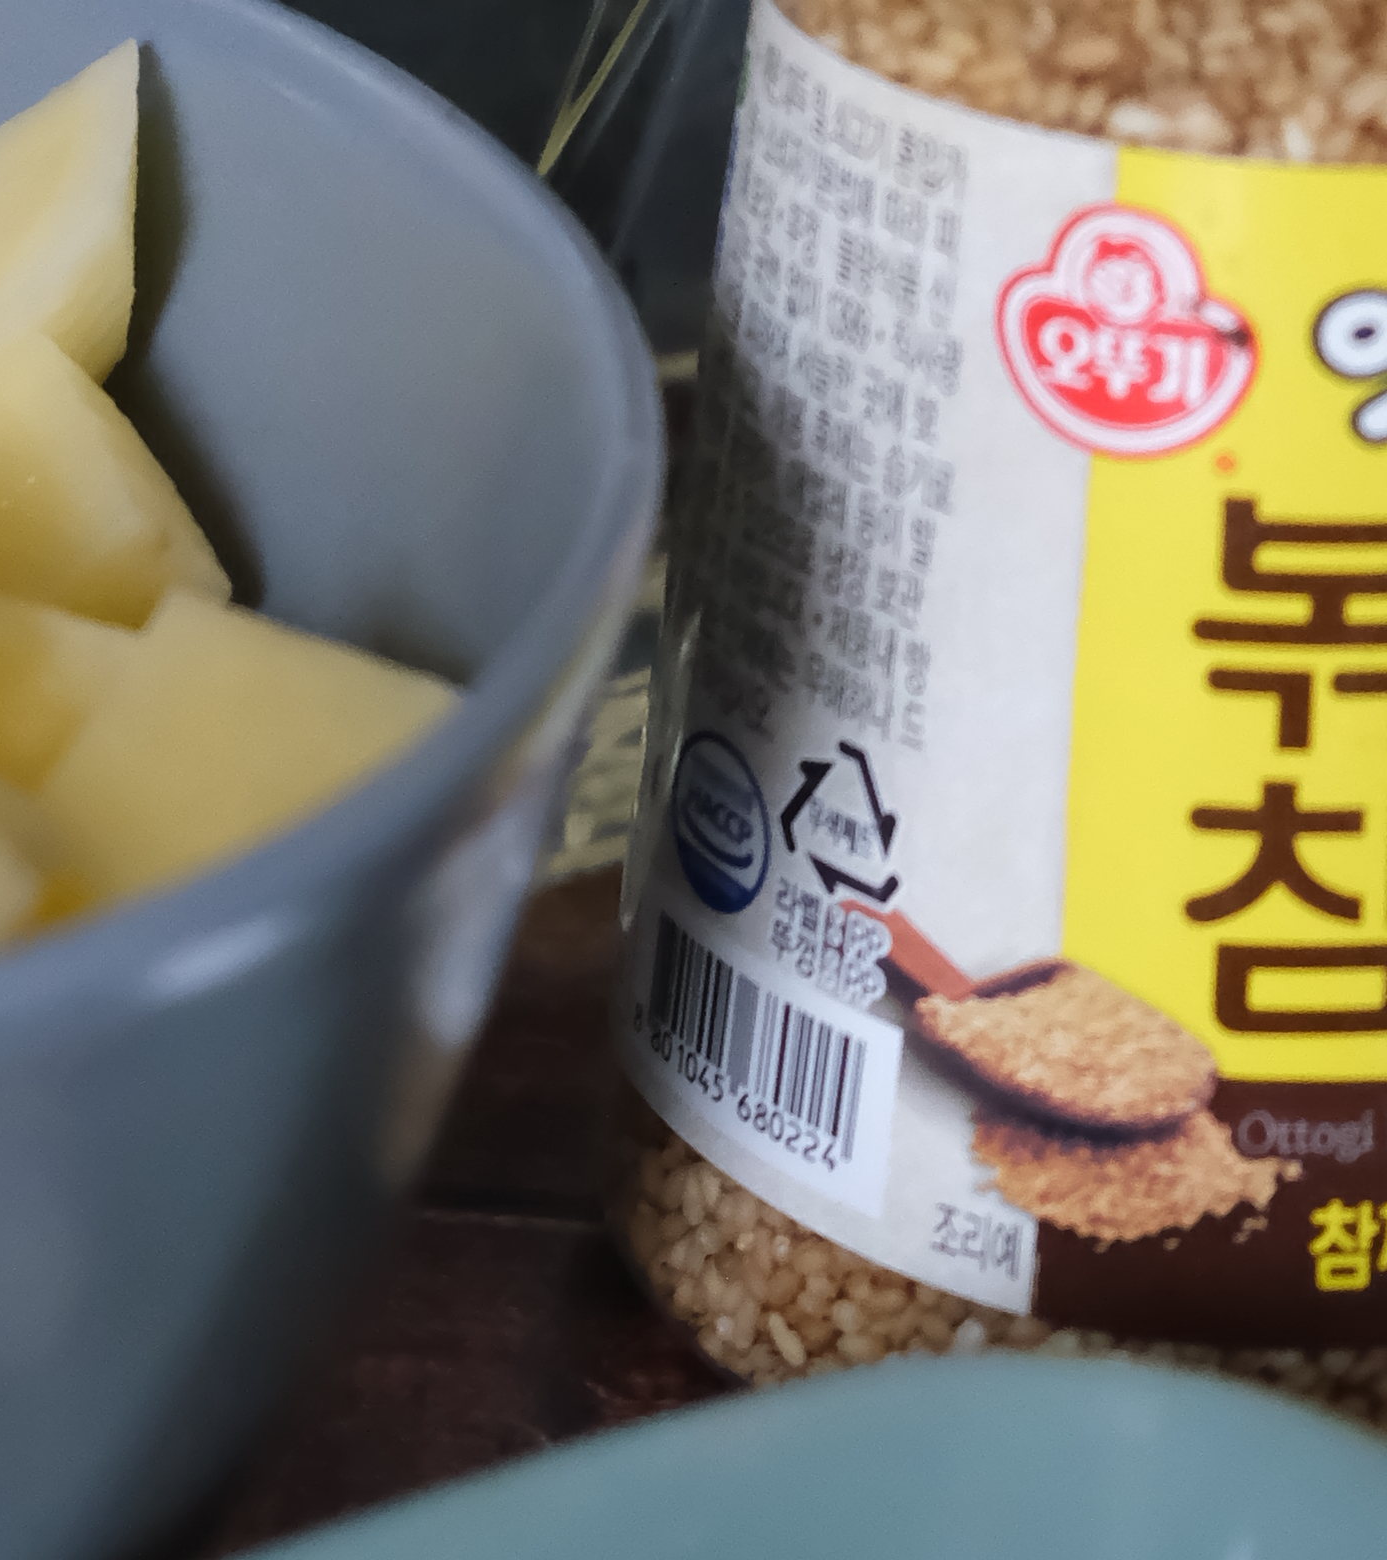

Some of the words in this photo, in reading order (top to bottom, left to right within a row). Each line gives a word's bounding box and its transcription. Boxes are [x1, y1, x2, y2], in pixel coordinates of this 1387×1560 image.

[1035, 313, 1211, 407] 오뚜기
[736, 1092, 837, 1173] 680224
[1236, 1108, 1376, 1165] Ottogi
[1309, 1196, 1387, 1294] 참
